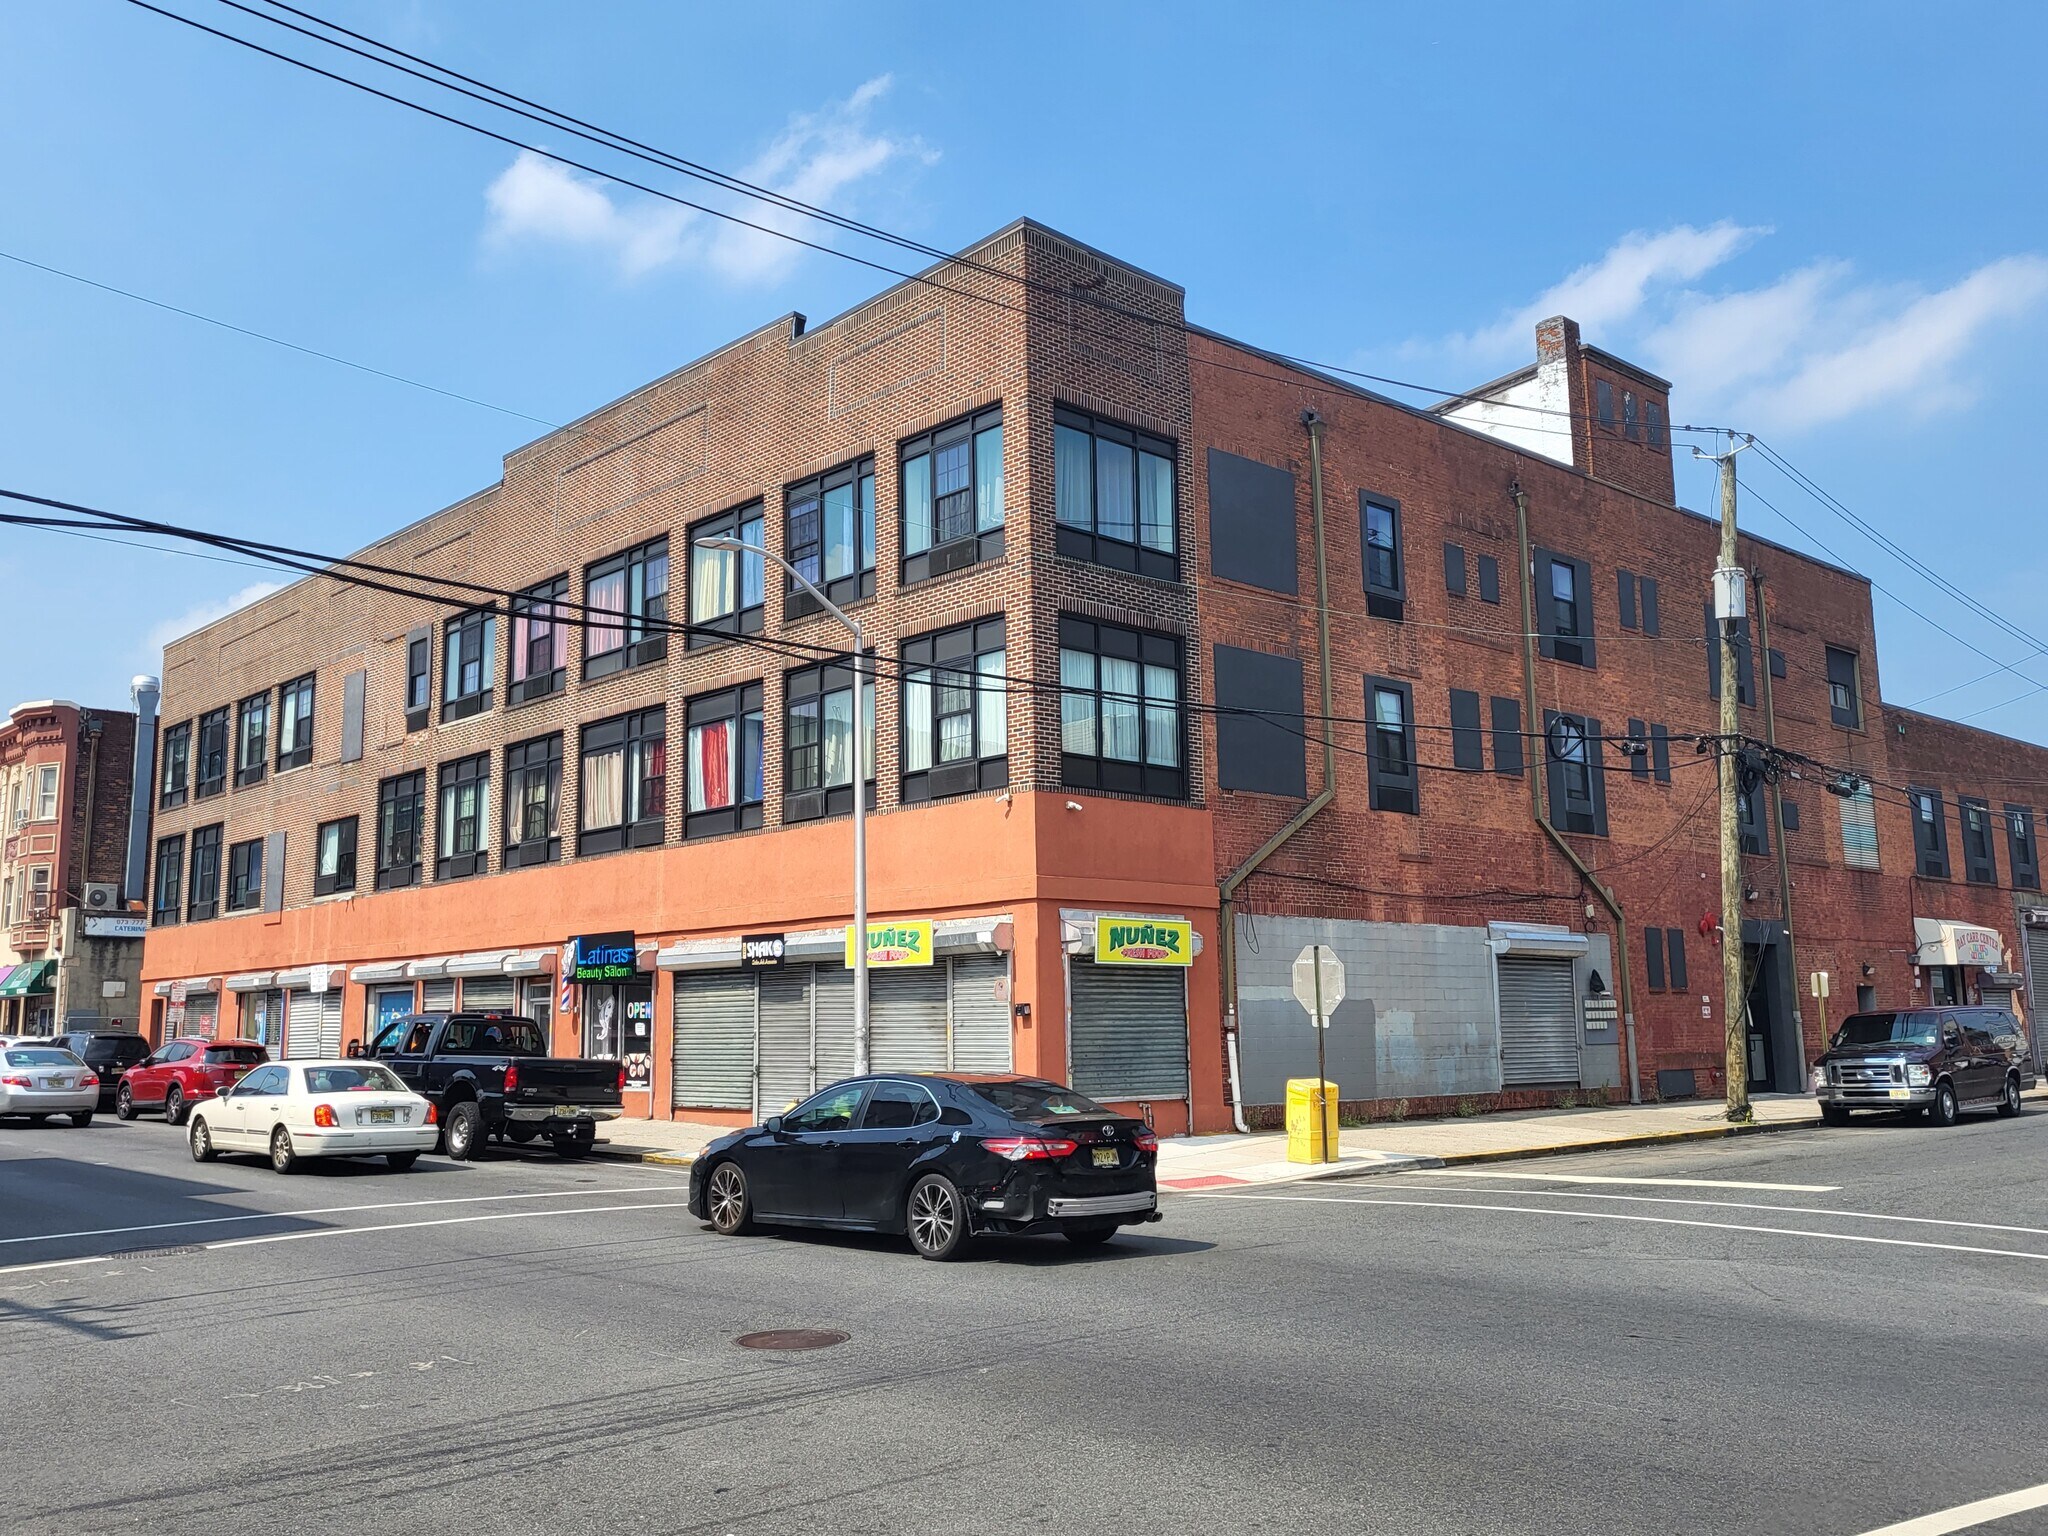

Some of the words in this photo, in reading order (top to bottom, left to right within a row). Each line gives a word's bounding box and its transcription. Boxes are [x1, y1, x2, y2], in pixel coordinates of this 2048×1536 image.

[577, 936, 630, 965] Latinas
[867, 927, 921, 953] UÑEZ
[1109, 924, 1180, 953] NUÑEZ
[576, 967, 603, 981] Beauty
[604, 965, 628, 978] Salon
[627, 1002, 652, 1019] OPEN
